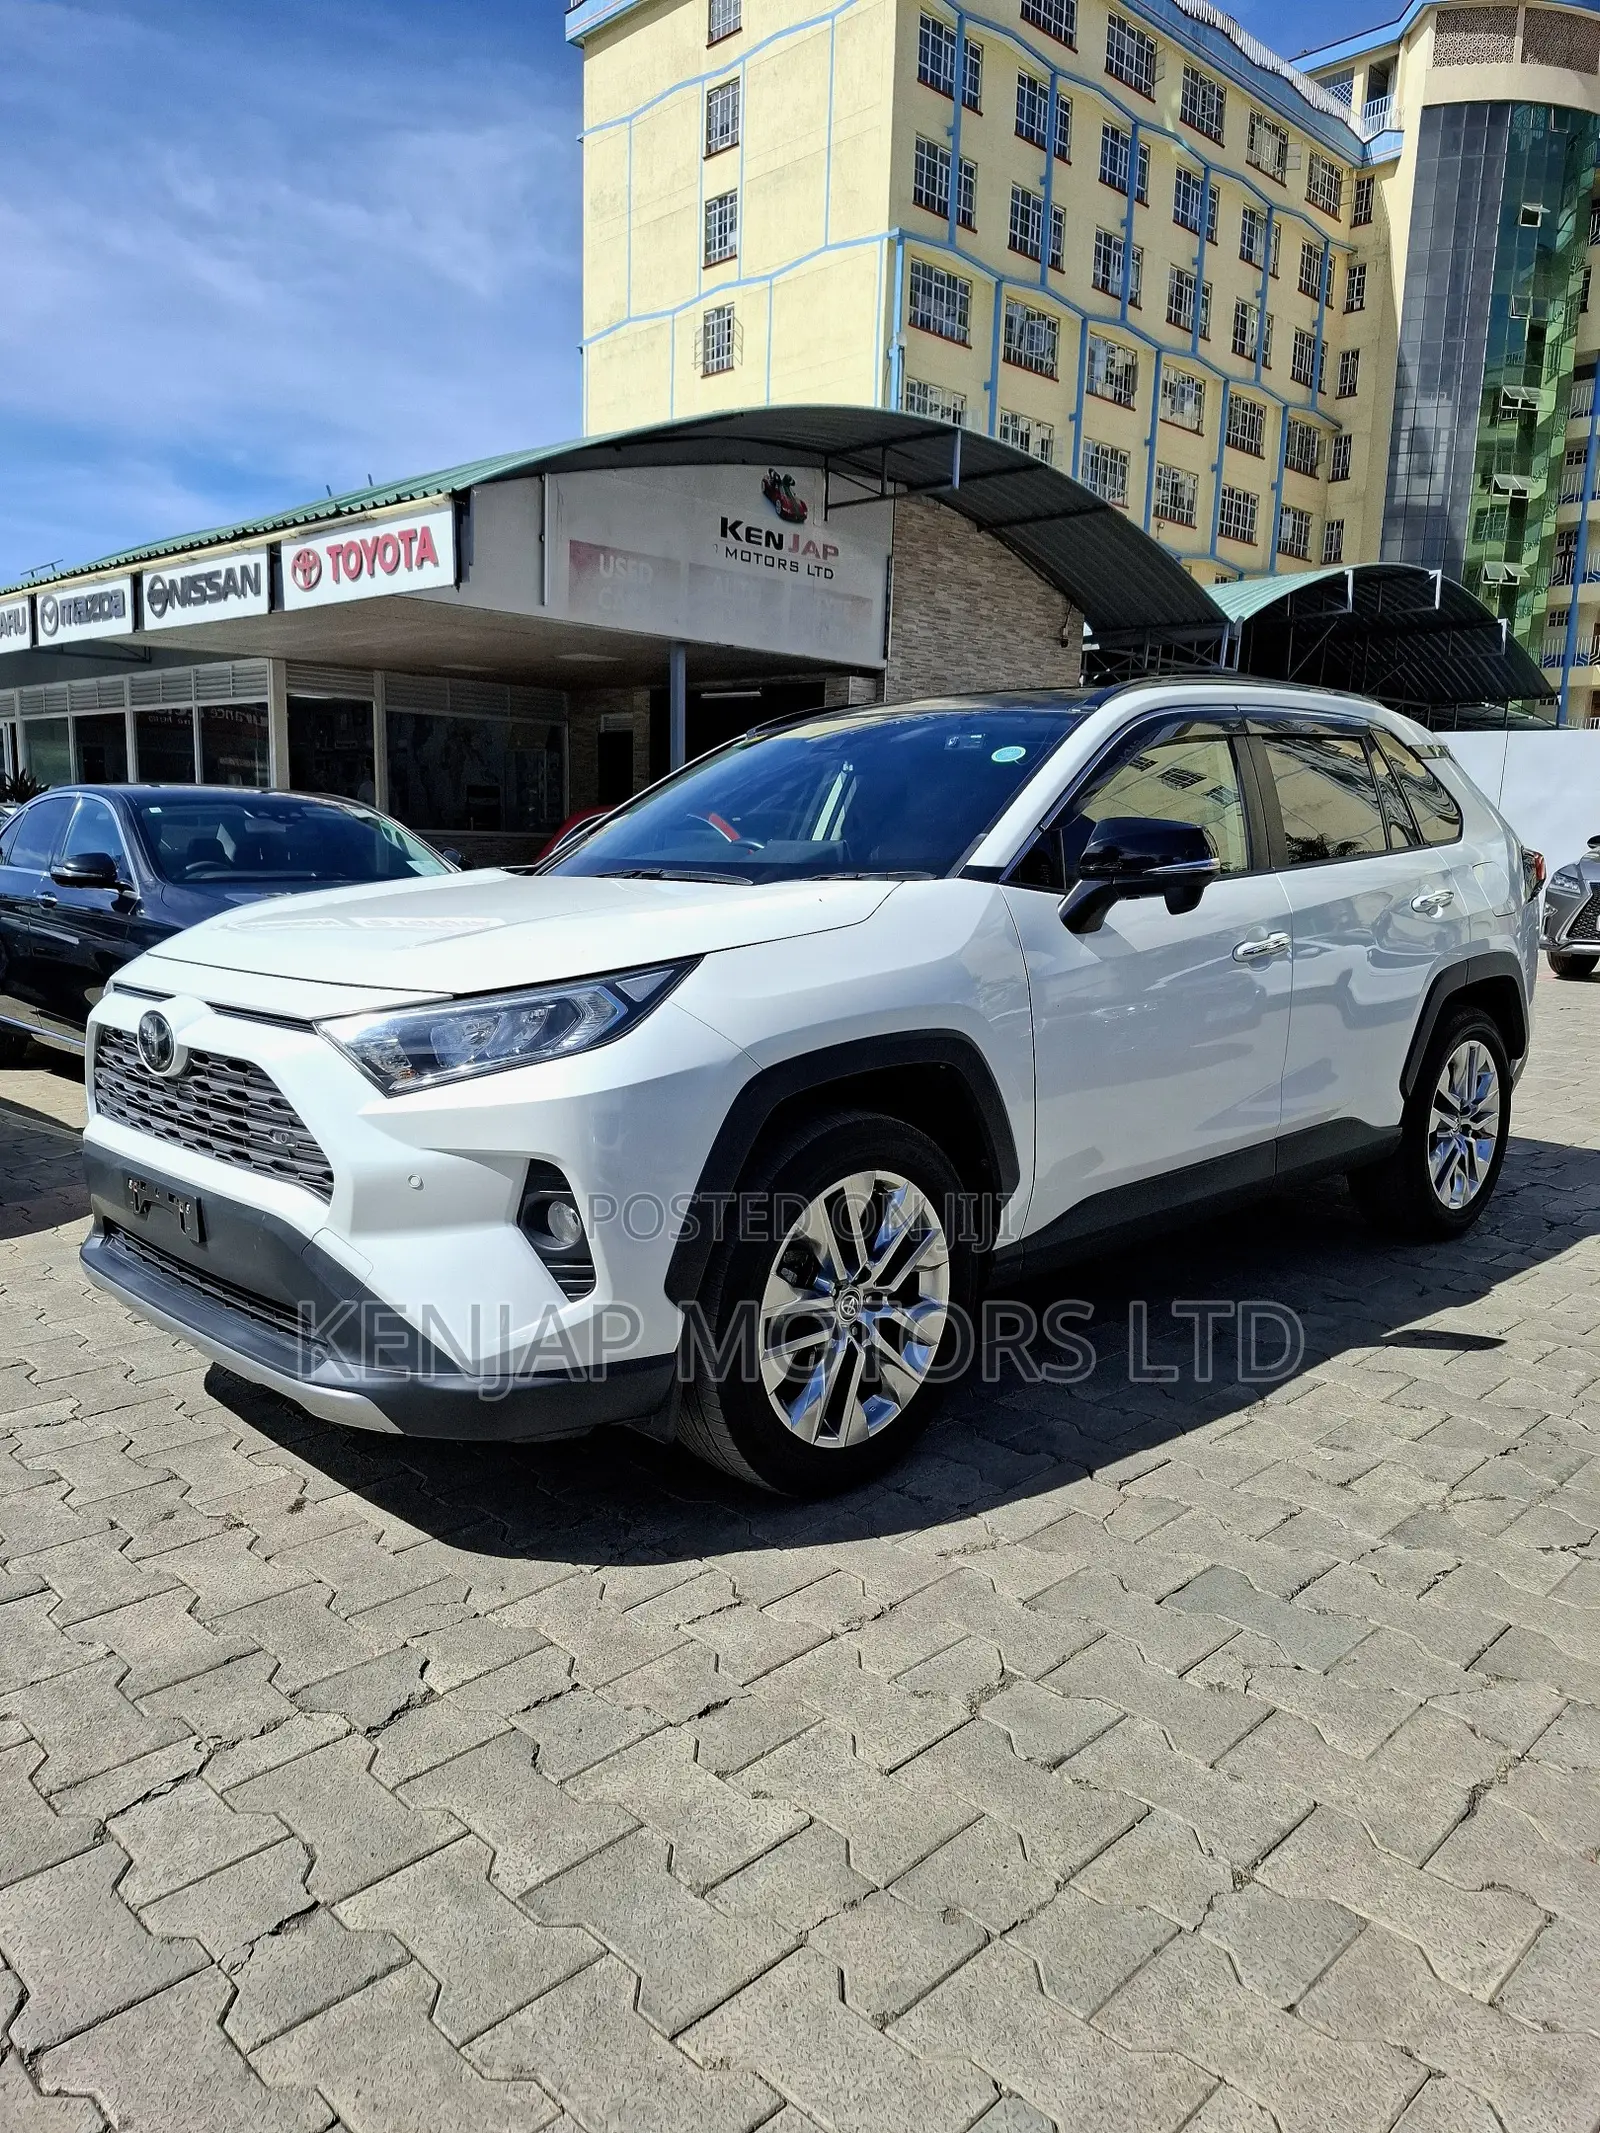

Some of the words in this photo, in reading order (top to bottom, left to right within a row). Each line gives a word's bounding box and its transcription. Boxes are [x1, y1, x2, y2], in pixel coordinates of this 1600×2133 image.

[327, 526, 439, 583] TOYOTA
[720, 516, 839, 561] KENJAP
[168, 562, 262, 609] NISSAN
[599, 553, 653, 583] USED
[725, 546, 799, 573] MOTORS
[807, 563, 834, 580] LTD
